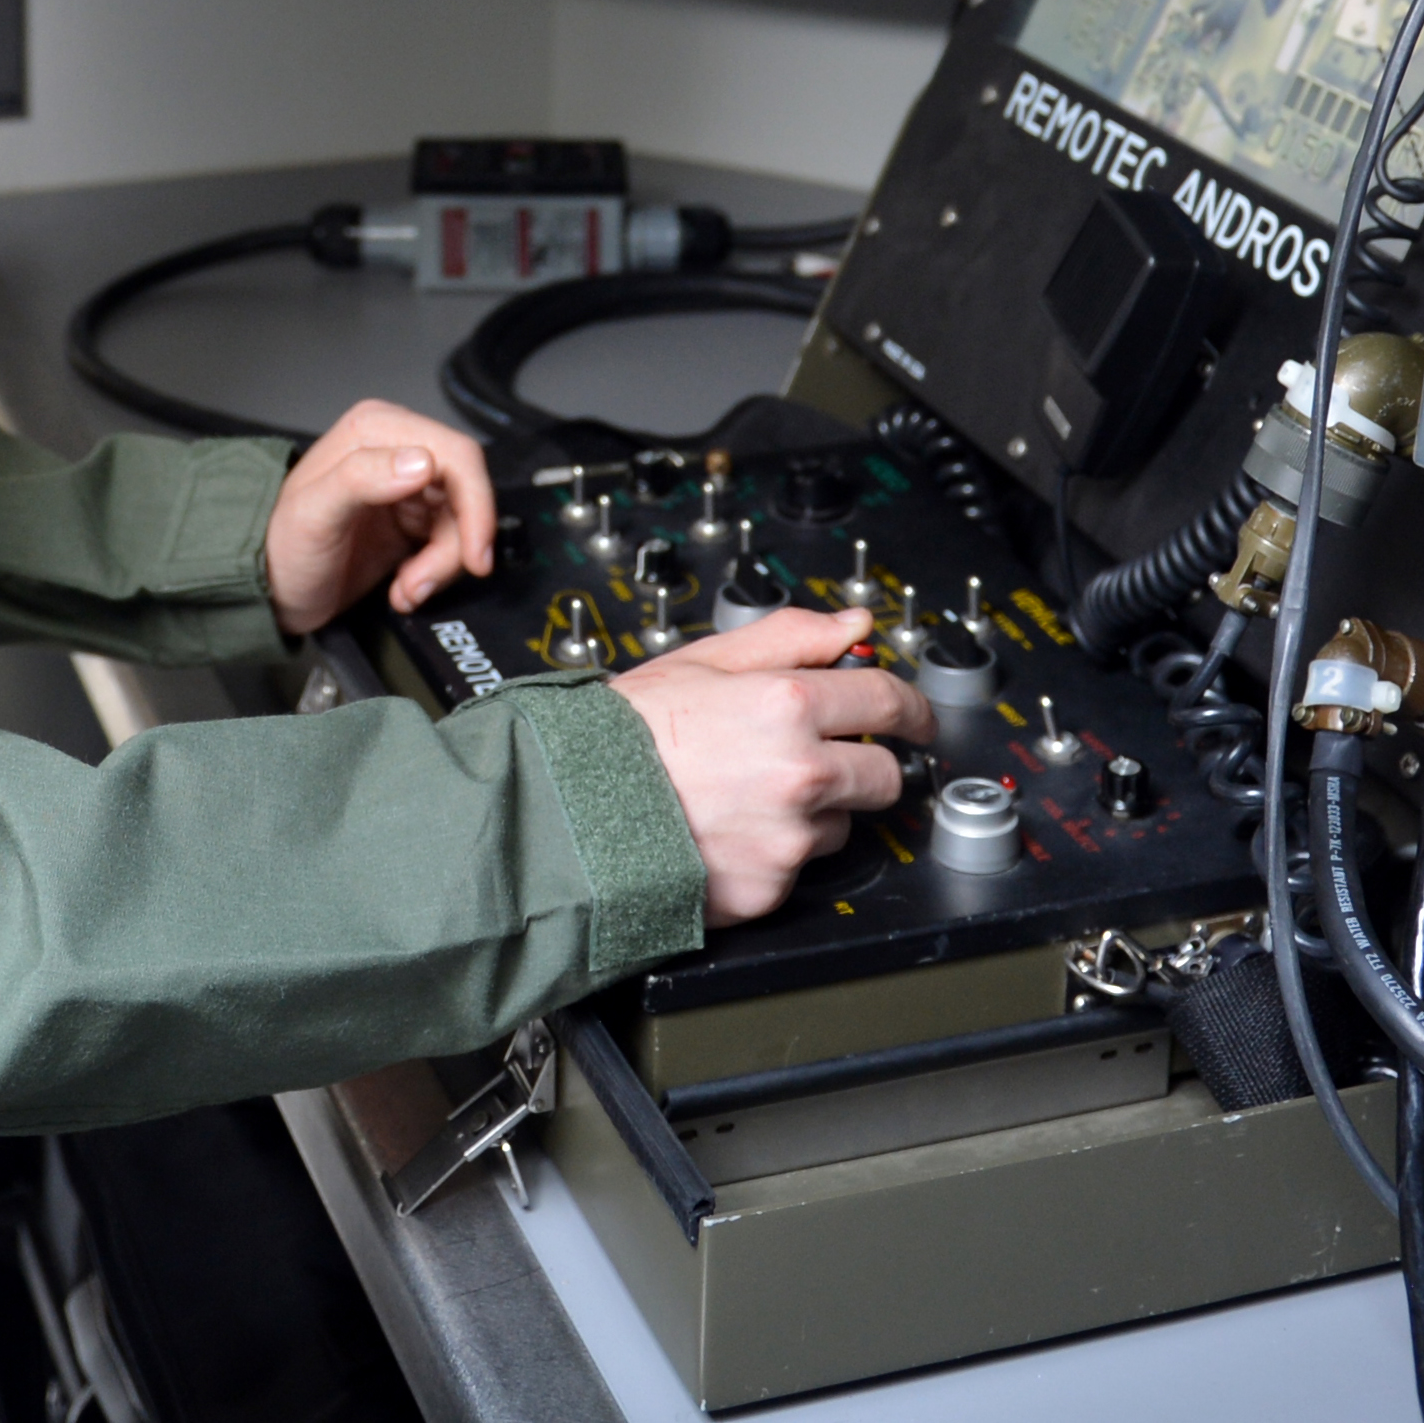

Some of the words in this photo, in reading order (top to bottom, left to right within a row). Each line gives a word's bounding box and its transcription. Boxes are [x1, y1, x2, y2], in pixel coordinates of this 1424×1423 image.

[1003, 71, 1168, 192] REMOTEC
[1172, 168, 1331, 299] ANDROS
[1319, 665, 1346, 697] 2
[1332, 866, 1354, 914] RESISTANT
[1344, 916, 1373, 951] WATER
[1364, 951, 1386, 972] FT2
[1380, 973, 1418, 1010] 225270
